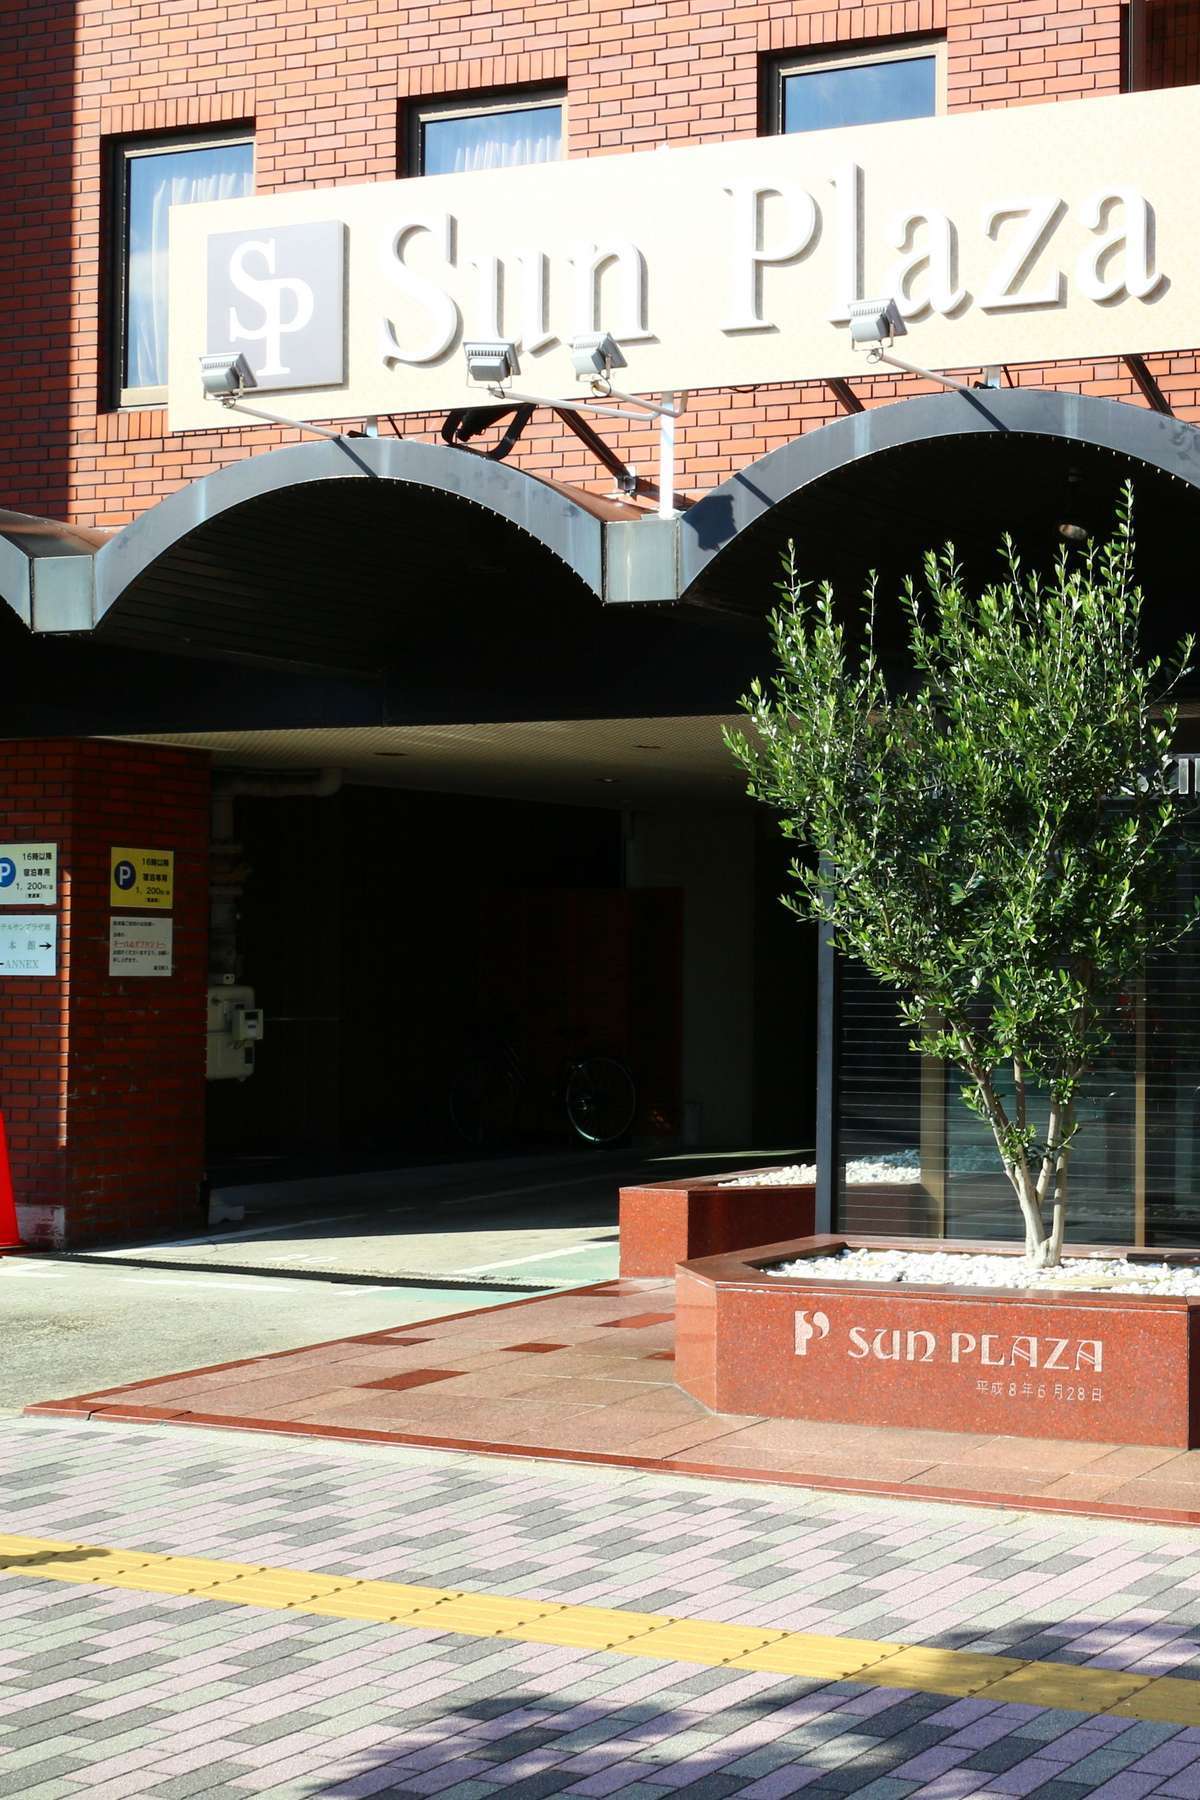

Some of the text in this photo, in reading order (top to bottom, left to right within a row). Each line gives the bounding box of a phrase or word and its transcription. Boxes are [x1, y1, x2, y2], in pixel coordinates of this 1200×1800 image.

[379, 161, 1170, 370] Sun Plaza
[5, 959, 39, 969] ANNEX
[951, 1331, 1103, 1373] PLAZA
